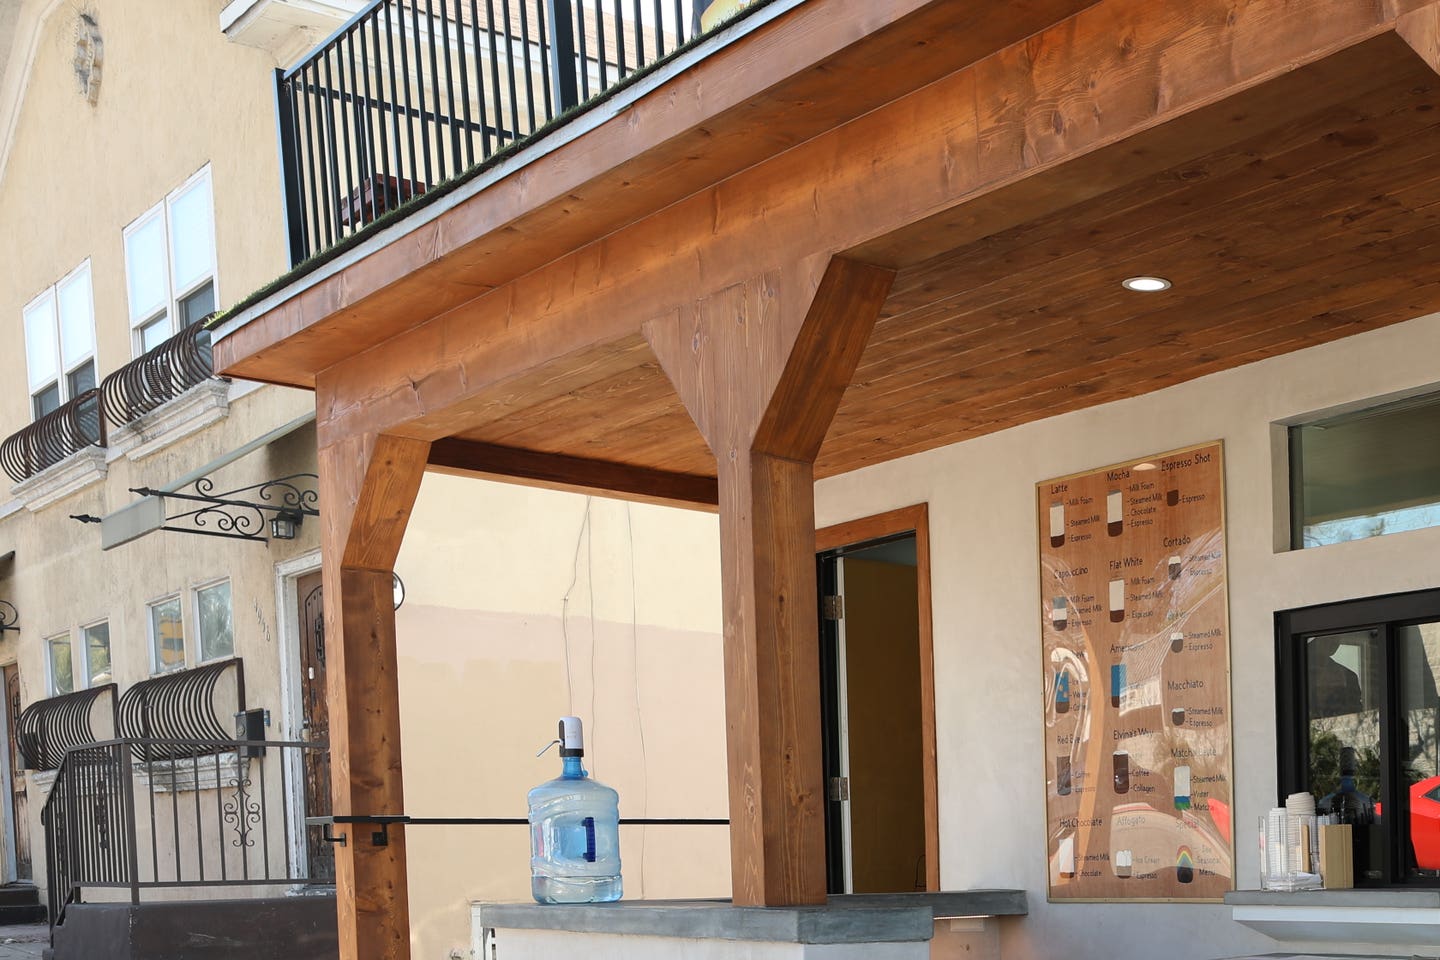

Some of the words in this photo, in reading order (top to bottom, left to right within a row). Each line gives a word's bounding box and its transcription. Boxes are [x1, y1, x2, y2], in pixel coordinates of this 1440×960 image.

[1161, 457, 1192, 472] Espresso
[1194, 454, 1210, 464] Shot
[1107, 470, 1130, 481] Mocha
[1051, 484, 1068, 494] Latte
[1131, 495, 1149, 505] Steamed
[1150, 493, 1162, 501] Milk
[1182, 494, 1205, 503] Espresso
[1131, 507, 1156, 516] Chocolate
[1071, 517, 1090, 526] Steamed
[1131, 519, 1153, 527] Espresso
[1163, 536, 1191, 547] Cortado
[1110, 560, 1122, 570] Flat
[1123, 558, 1143, 568] White
[1131, 593, 1151, 601] Steamed
[1132, 610, 1153, 619] Espresso
[1188, 631, 1209, 639] Steamed
[1210, 629, 1221, 637] Milk
[1188, 643, 1213, 652] Espresso
[1168, 680, 1204, 690] Macchiato
[1190, 719, 1213, 727] Espresso
[1171, 748, 1197, 758] Match
[1193, 776, 1215, 784] Steamed
[1133, 785, 1155, 793] Collagen
[1060, 818, 1070, 827] Hot
[1072, 817, 1102, 827] Chocolate
[1117, 816, 1145, 826] Affogato
